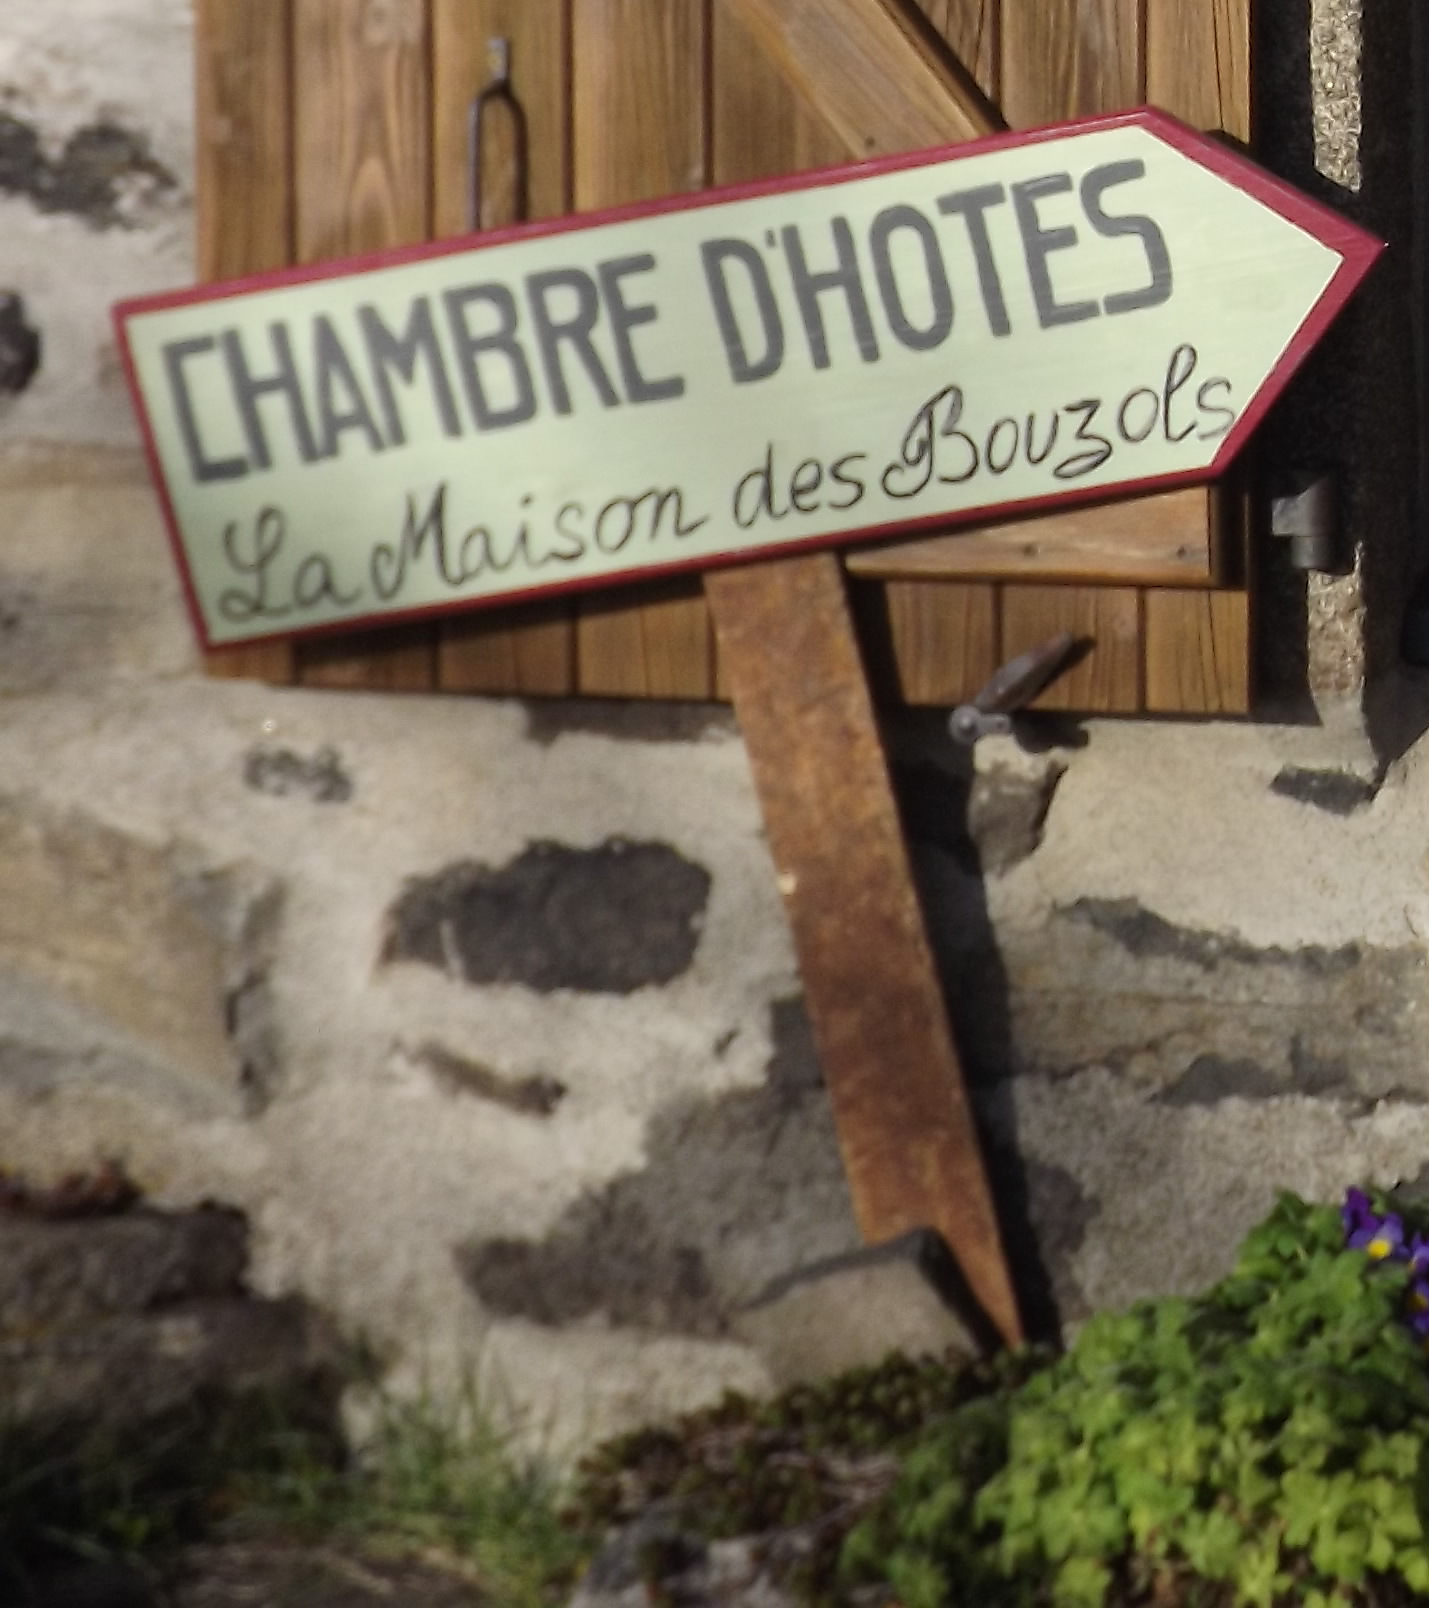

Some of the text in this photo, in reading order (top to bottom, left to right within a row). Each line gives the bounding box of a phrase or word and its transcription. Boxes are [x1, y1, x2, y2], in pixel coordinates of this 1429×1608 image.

[162, 160, 1173, 482] CHAMBRE D'HOTES
[220, 344, 1236, 617] La Maison des Bouzols
